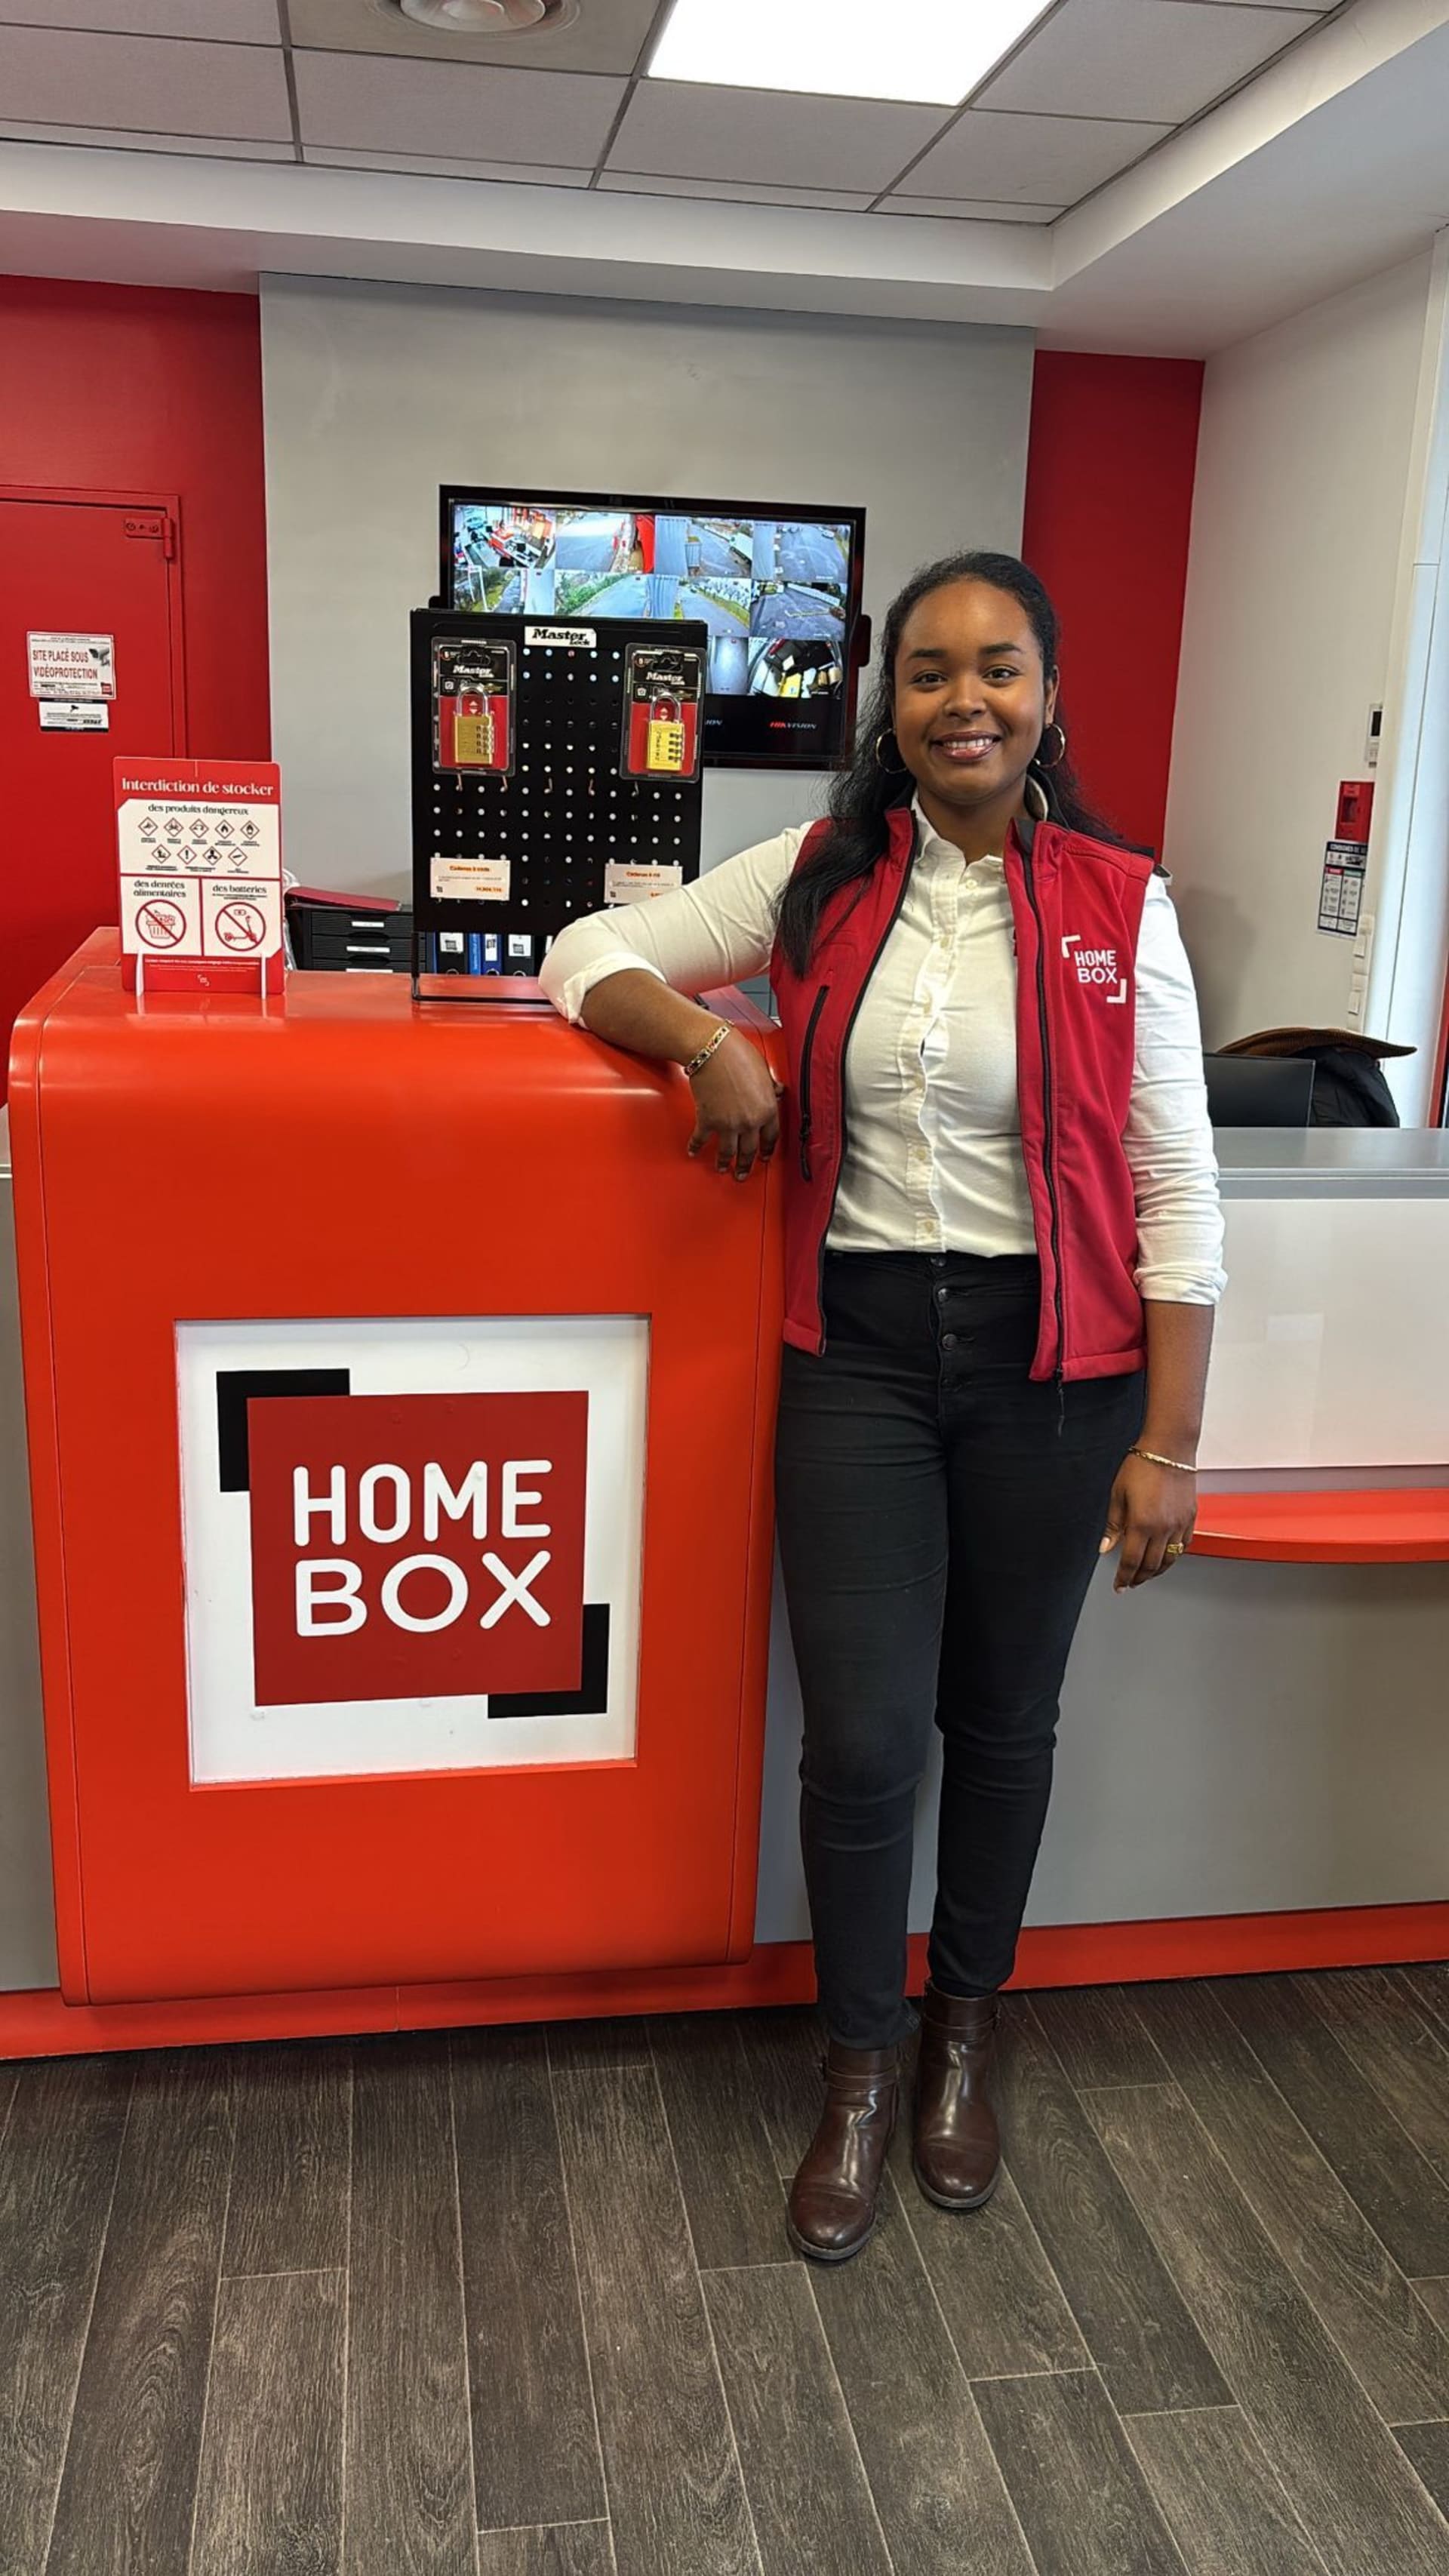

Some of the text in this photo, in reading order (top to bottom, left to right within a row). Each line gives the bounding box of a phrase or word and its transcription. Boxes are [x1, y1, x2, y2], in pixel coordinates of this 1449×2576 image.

[532, 628, 586, 640] Master
[32, 648, 88, 663] SITE PLACÉ SOUS
[33, 664, 97, 679] VIDÉOPROTECTION
[453, 665, 492, 674] Master
[646, 672, 684, 682] Master
[769, 721, 817, 729] HIKVISION
[122, 777, 274, 796] Interdiction de stocker
[148, 804, 249, 815] des produits dangereux
[134, 880, 185, 889] des denrées
[229, 885, 267, 894] batteries
[134, 888, 186, 898] alimentaires
[1074, 949, 1116, 966] HOME
[1077, 967, 1118, 984] BOX
[293, 1460, 552, 1547] HOME
[295, 1550, 552, 1636] BOX
